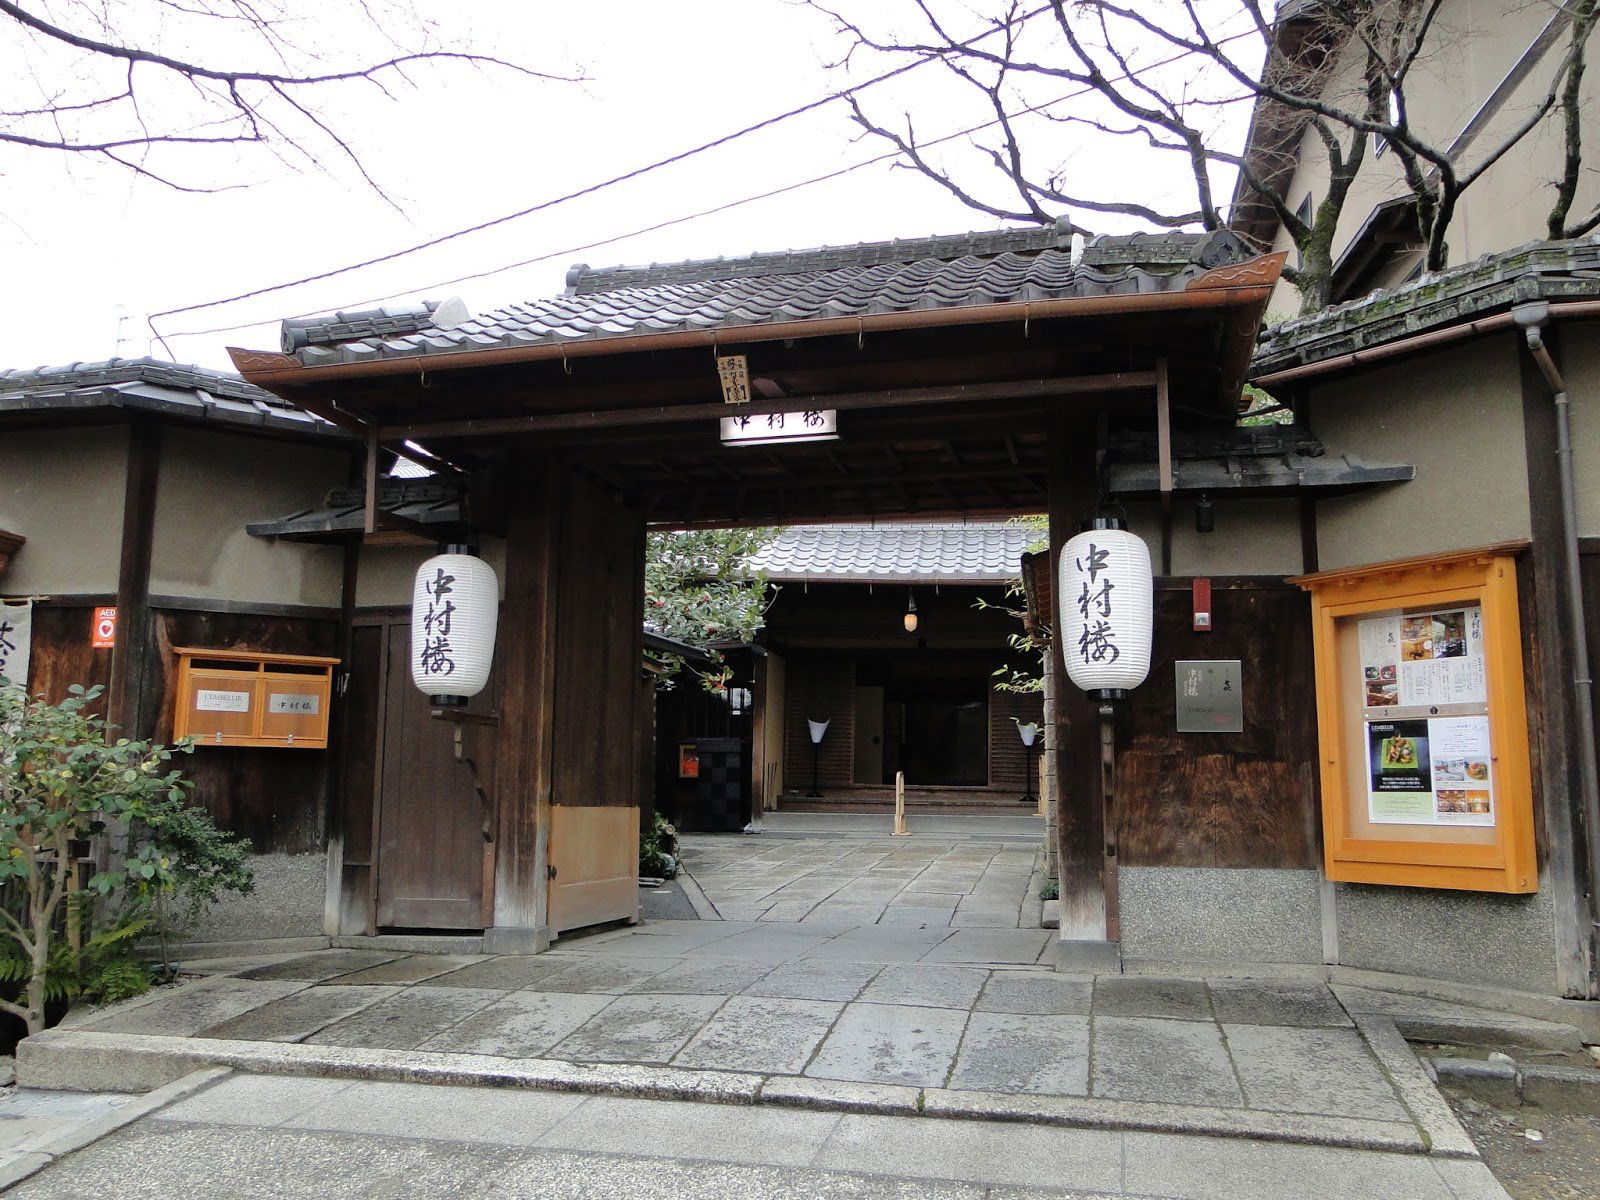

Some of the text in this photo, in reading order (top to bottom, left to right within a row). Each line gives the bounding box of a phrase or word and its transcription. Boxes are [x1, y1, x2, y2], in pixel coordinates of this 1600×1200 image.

[99, 608, 116, 617] AED
[421, 568, 456, 676] 中村楼
[1075, 543, 1120, 665] 中村楼
